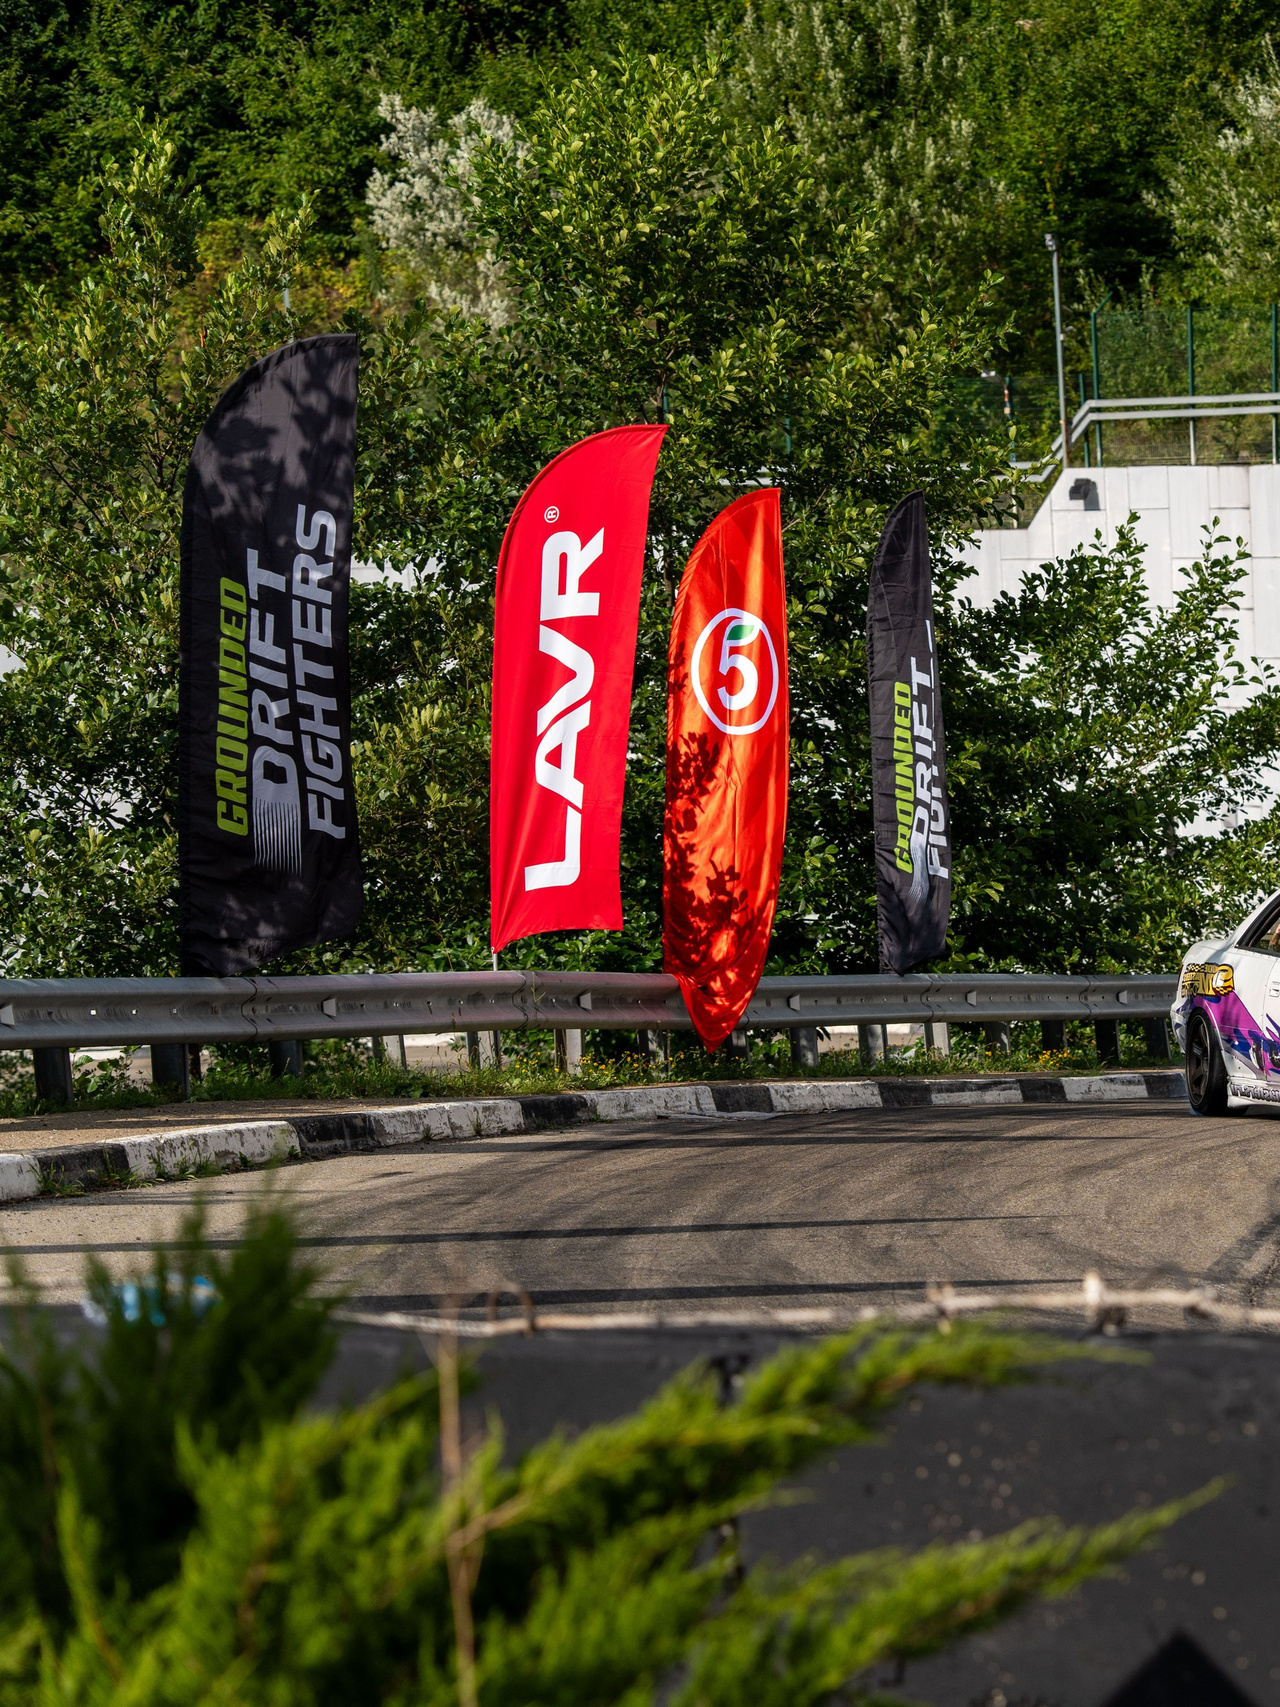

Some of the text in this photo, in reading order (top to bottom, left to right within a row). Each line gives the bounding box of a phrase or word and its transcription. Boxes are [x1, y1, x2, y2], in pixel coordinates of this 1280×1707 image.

[215, 576, 248, 837] GROUNDED
[246, 547, 302, 874] DRIFT
[292, 503, 346, 840] FIGHTERS
[717, 619, 760, 711] 5
[893, 681, 915, 874] GROUNDED
[909, 656, 933, 903] DRIFT
